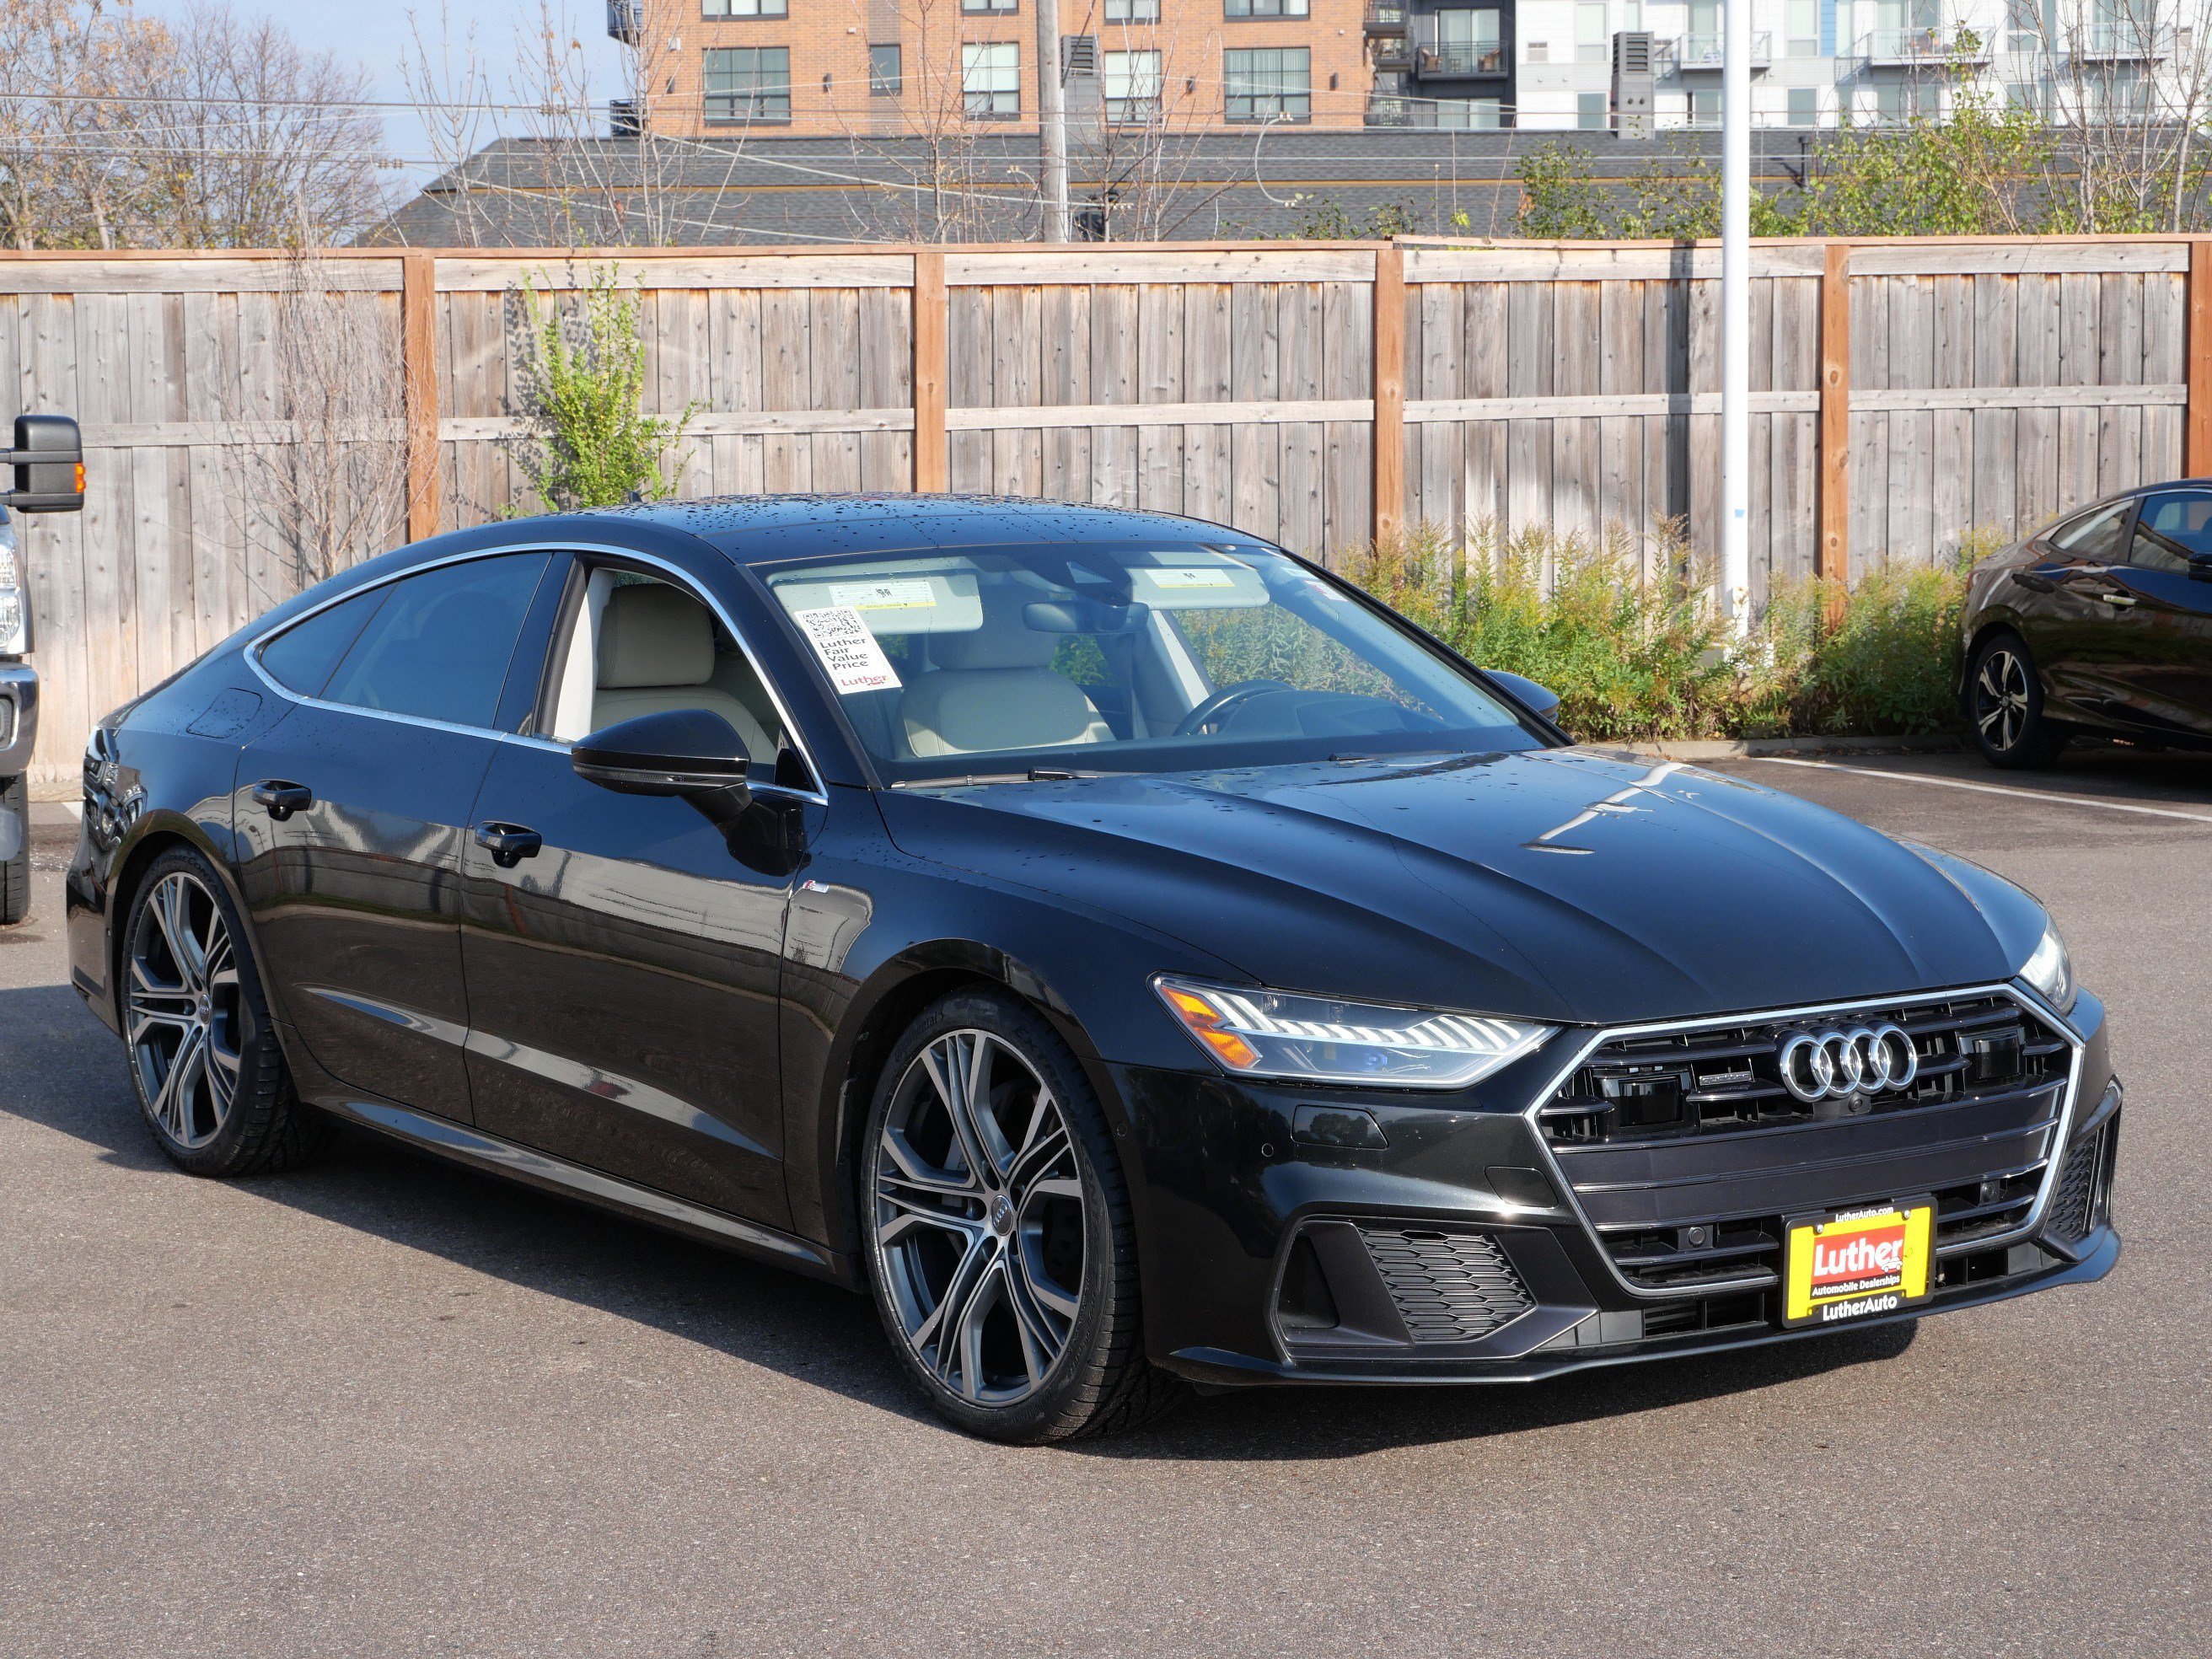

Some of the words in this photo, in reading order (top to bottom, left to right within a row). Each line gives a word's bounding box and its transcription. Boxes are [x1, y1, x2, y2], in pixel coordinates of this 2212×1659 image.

[819, 637, 867, 649] Luther
[824, 647, 850, 656] Fair
[827, 652, 868, 663] Value
[832, 661, 869, 671] Price
[840, 674, 887, 686] Luther
[1835, 1206, 1894, 1223] LutherAuto.com
[1813, 1237, 1903, 1277] Luther
[1812, 1280, 1859, 1297] Automobile
[1859, 1274, 1901, 1291] Dealerships
[1823, 1295, 1898, 1322] LutherAuto
